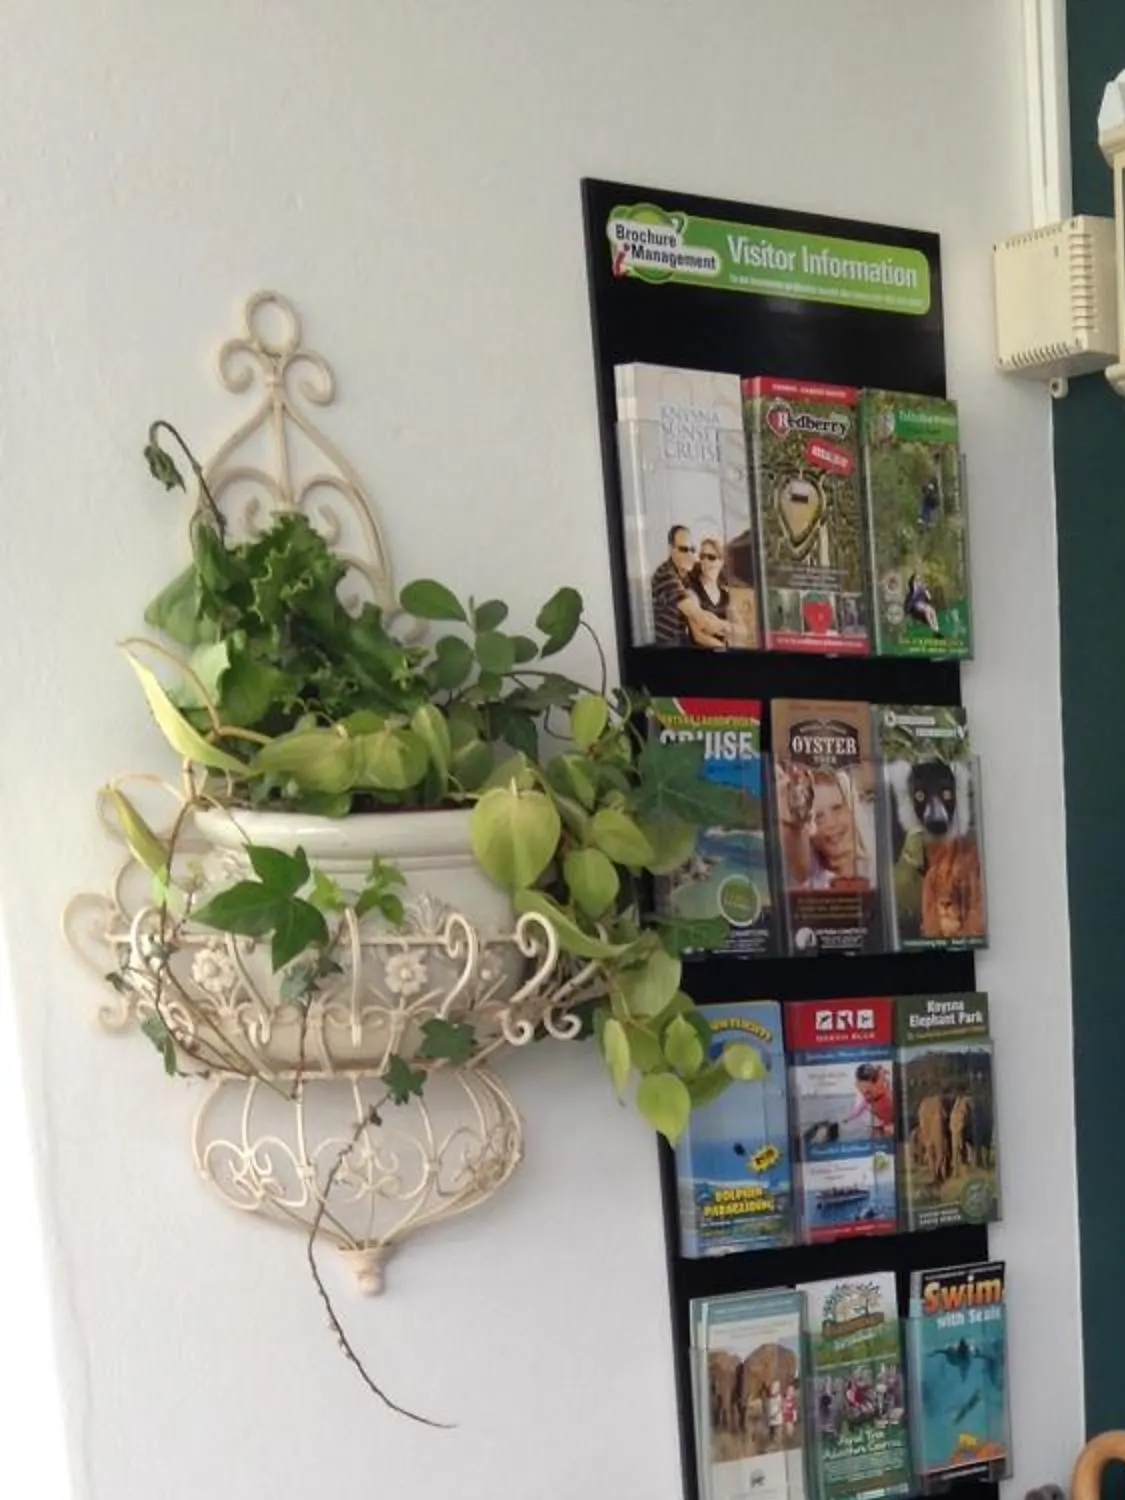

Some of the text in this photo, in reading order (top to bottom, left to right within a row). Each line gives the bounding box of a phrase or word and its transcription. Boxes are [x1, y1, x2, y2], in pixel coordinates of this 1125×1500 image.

[616, 223, 677, 248] Brochure
[631, 243, 717, 270] Management
[727, 234, 918, 288] Visitor Information
[778, 409, 847, 437] Redberry
[791, 735, 858, 755] OYSTER
[909, 1010, 984, 1029] Elephant Park
[923, 1274, 1002, 1315] Swim
[936, 1310, 965, 1329] with
